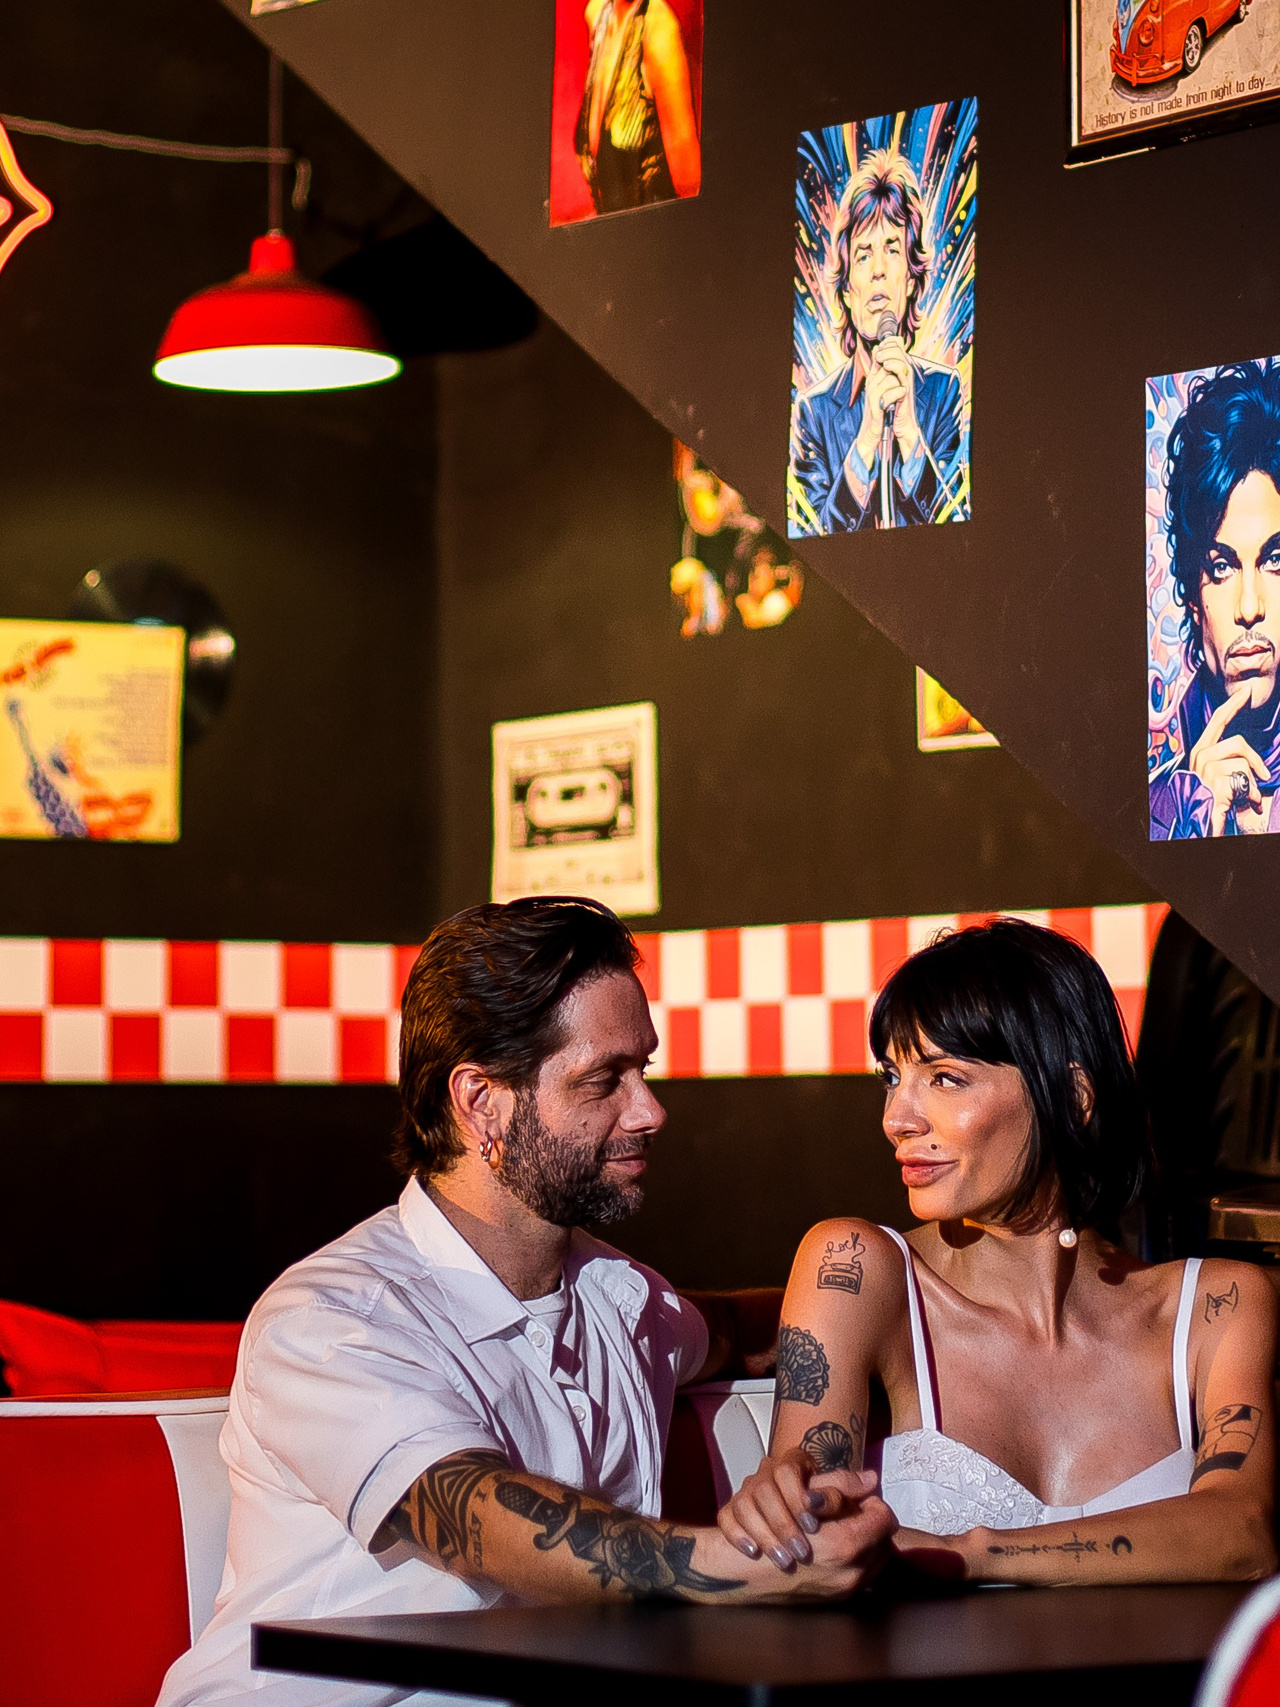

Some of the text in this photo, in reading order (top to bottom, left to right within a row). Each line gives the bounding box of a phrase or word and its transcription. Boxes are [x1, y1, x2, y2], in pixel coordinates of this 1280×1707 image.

[1095, 111, 1126, 128] History
[1129, 106, 1137, 119] is
[1140, 101, 1154, 116] not
[1157, 96, 1182, 112] made
[1186, 91, 1207, 107] from
[1210, 82, 1232, 100] night
[1236, 80, 1245, 93] to
